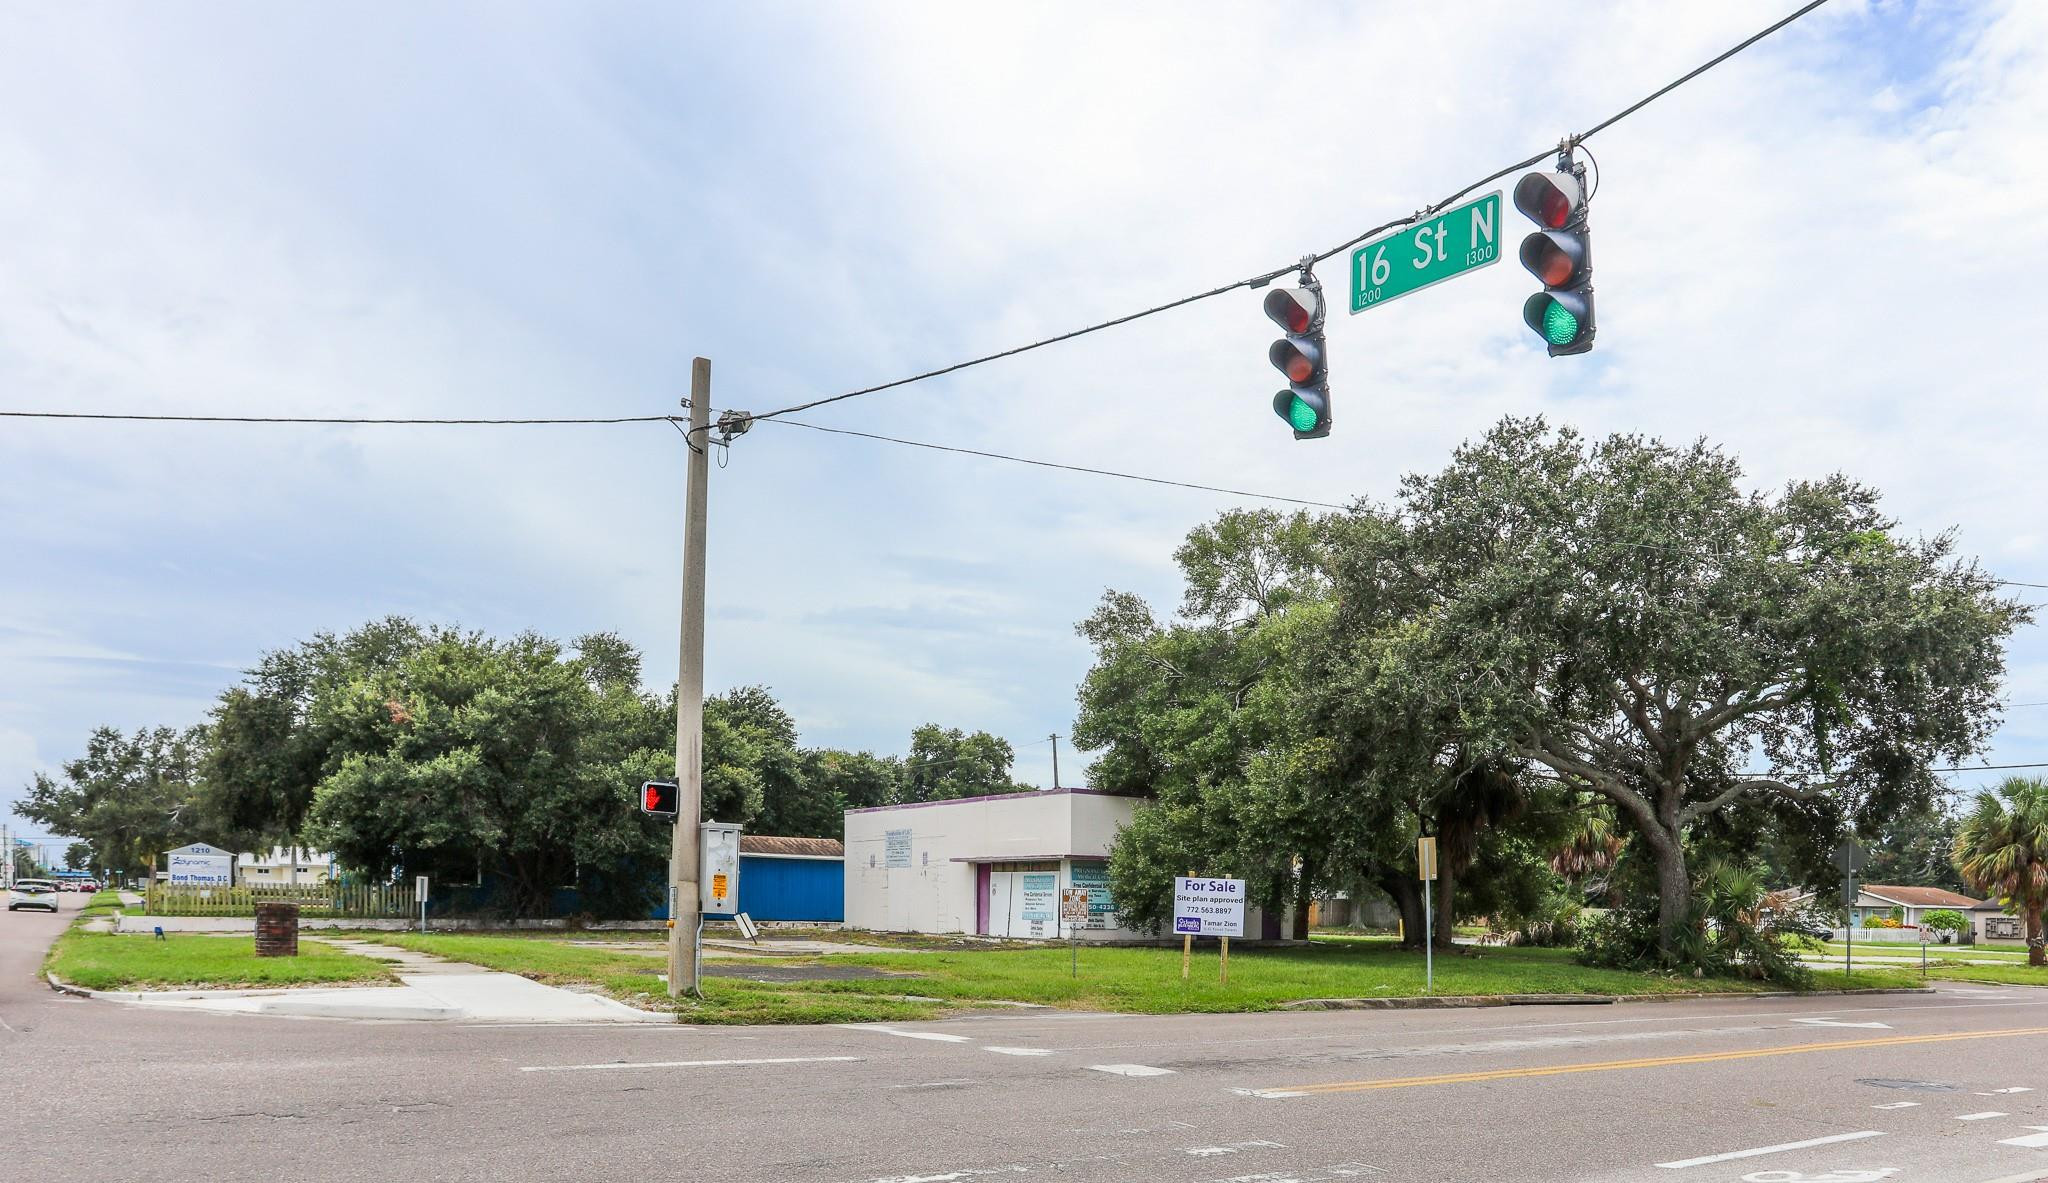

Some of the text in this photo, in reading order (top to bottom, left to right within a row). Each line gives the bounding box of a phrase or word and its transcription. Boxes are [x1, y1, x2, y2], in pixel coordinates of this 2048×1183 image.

[1359, 200, 1494, 291] 16 St N
[1466, 245, 1493, 266] 1300
[1358, 287, 1381, 307] 1200
[1185, 880, 1235, 892] For Sale
